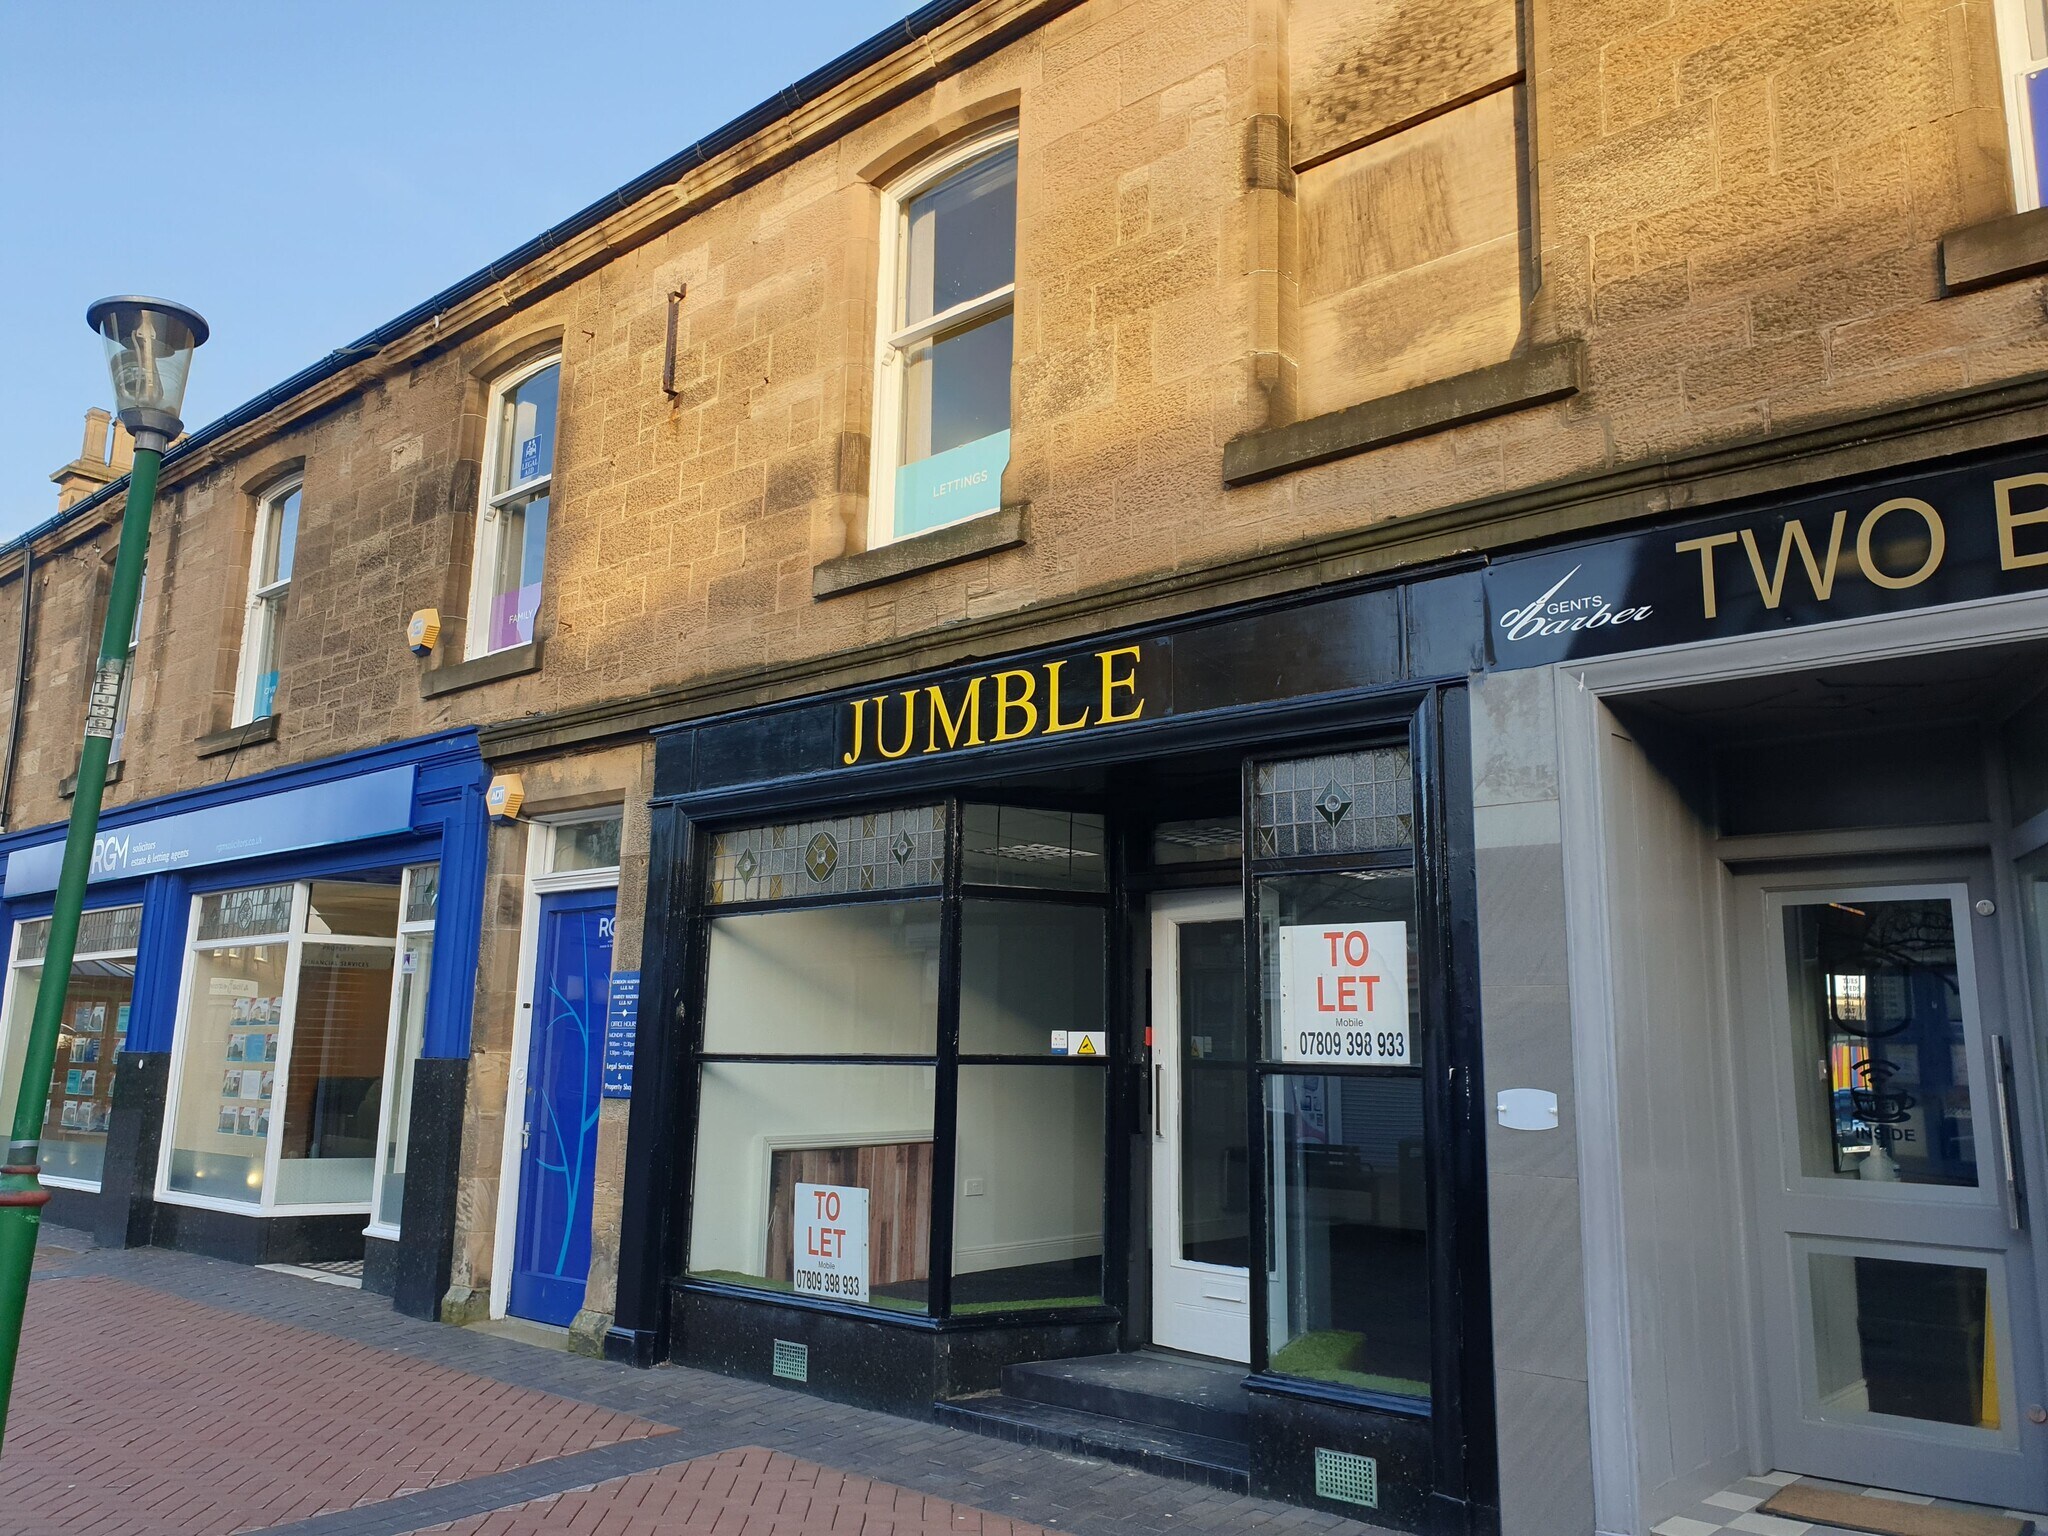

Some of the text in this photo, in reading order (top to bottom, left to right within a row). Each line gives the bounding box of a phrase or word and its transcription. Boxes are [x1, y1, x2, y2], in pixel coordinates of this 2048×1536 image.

[522, 458, 539, 471] LEGAL
[933, 470, 988, 497] LETTINGS
[1675, 497, 1946, 620] TWO
[508, 608, 534, 625] FAMILY
[1547, 595, 1603, 615] GENTS
[843, 645, 1145, 765] JUMBLE
[491, 789, 504, 801] ADT
[92, 834, 130, 874] RGM
[131, 857, 147, 867] estate
[147, 854, 152, 864] &
[170, 848, 190, 861] agents
[132, 841, 157, 853] solicitors
[1323, 930, 1370, 968] TO
[1317, 975, 1381, 1012] LET
[1335, 1018, 1364, 1028] Mobile
[1300, 1031, 1405, 1057] 07809 398 933
[606, 1062, 618, 1071] Legal
[604, 1083, 623, 1092] Property
[813, 1191, 841, 1221] TO
[807, 1226, 846, 1258] LET
[818, 1260, 836, 1270] Mobile
[796, 1269, 860, 1296] 07809 398 933
